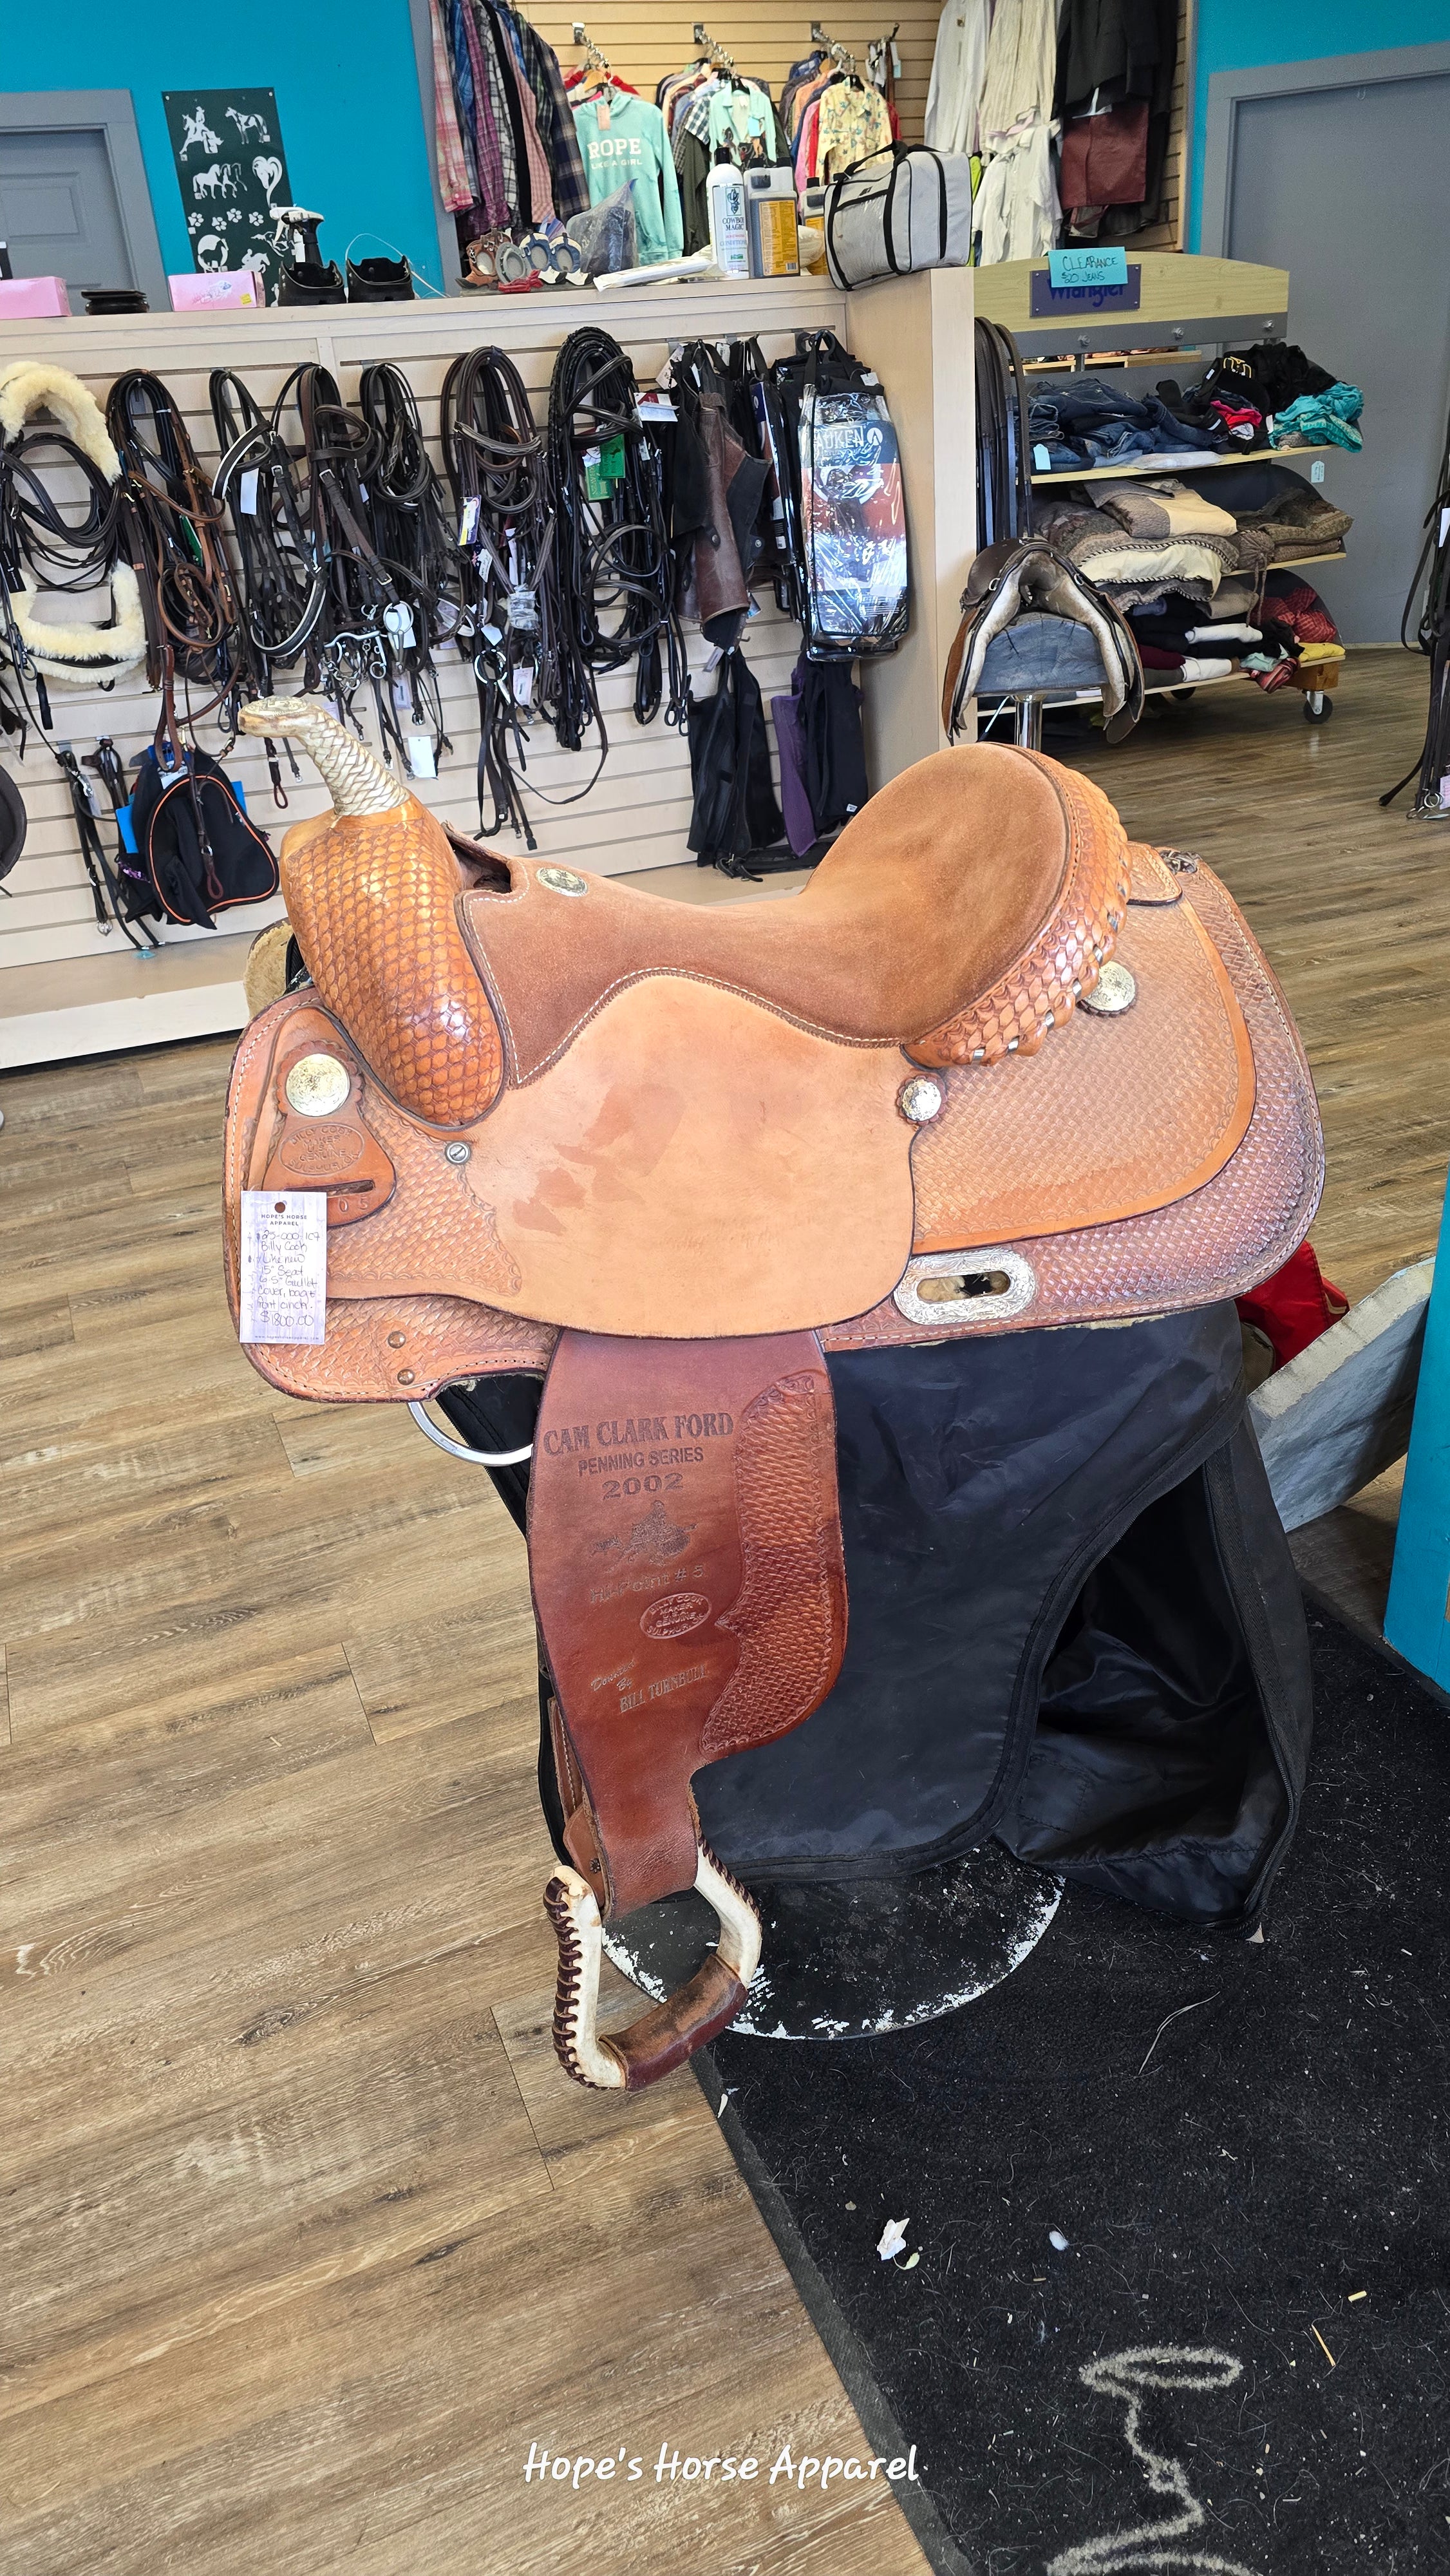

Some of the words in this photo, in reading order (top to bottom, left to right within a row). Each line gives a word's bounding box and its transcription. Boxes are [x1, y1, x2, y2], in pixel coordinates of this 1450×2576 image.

[587, 138, 641, 160] ROPE
[1062, 256, 1118, 271] CLEARANCE
[1061, 272, 1079, 283] $20
[1082, 271, 1106, 282] JEANS
[261, 1240, 281, 1256] Billy
[285, 1241, 307, 1252] Cook
[285, 1253, 305, 1264] new
[278, 1265, 303, 1276] Seat
[543, 1425, 590, 1456] CAM
[596, 1417, 669, 1446] CLARK
[673, 1412, 734, 1439] FORD
[578, 1451, 645, 1475] PENNING
[648, 1446, 704, 1466] SERIES
[601, 1472, 684, 1500] 2002
[674, 1568, 687, 1582] #
[692, 1565, 704, 1578] 5
[650, 1598, 674, 1615] BILLY
[676, 1595, 704, 1605] COOK
[655, 1612, 697, 1628] GENUINE
[619, 1689, 646, 1714] BILL
